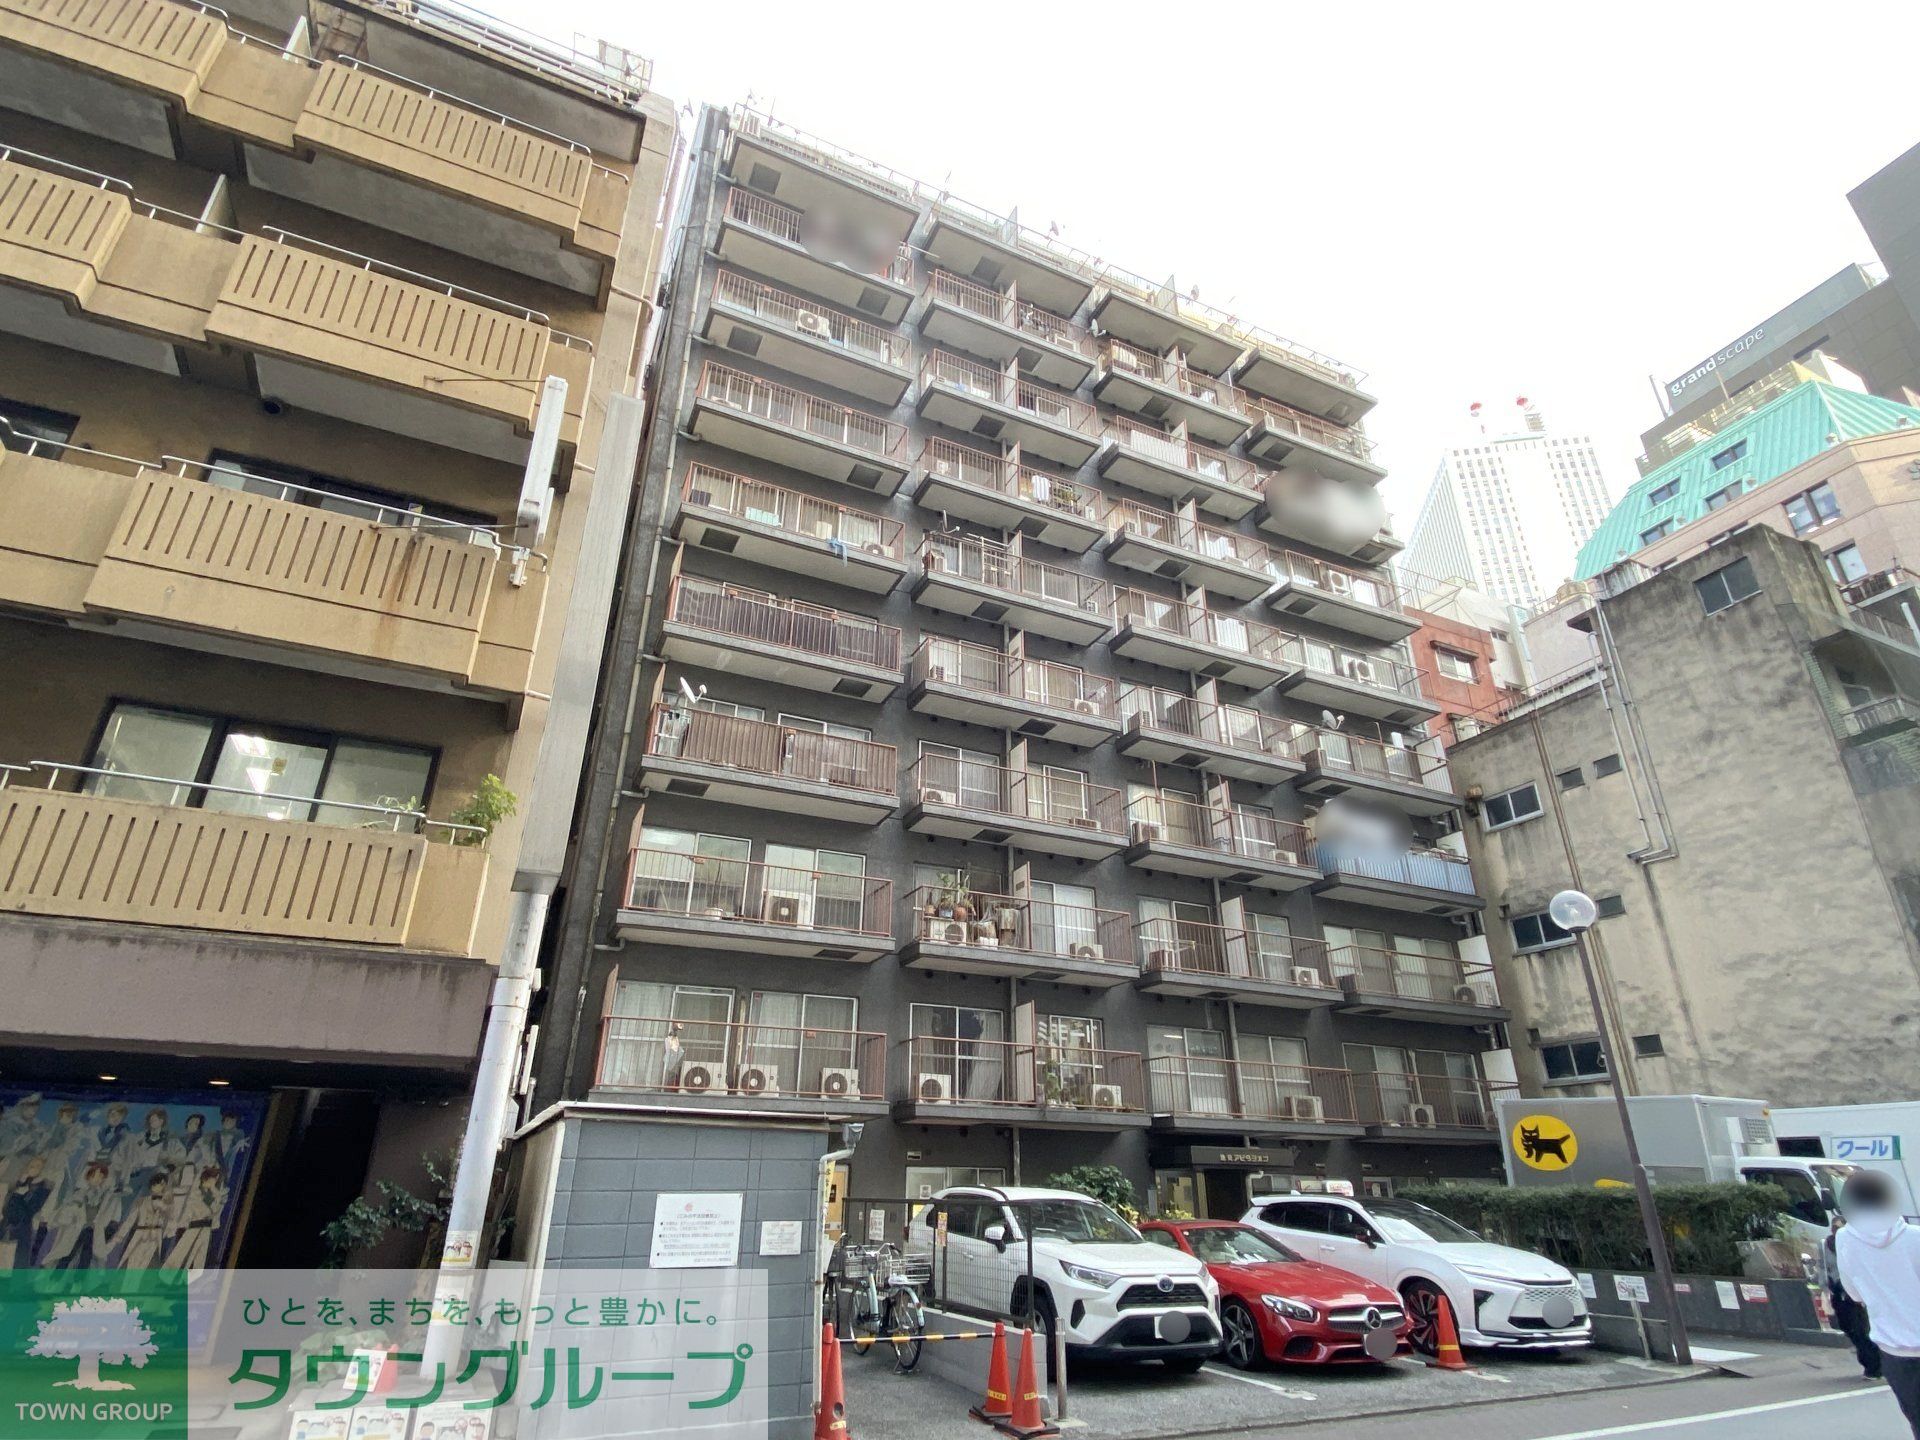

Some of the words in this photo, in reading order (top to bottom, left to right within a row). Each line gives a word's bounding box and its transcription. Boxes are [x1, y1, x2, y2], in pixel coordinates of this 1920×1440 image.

[1670, 328, 1765, 397] grandscape
[1836, 1139, 1889, 1159] クール
